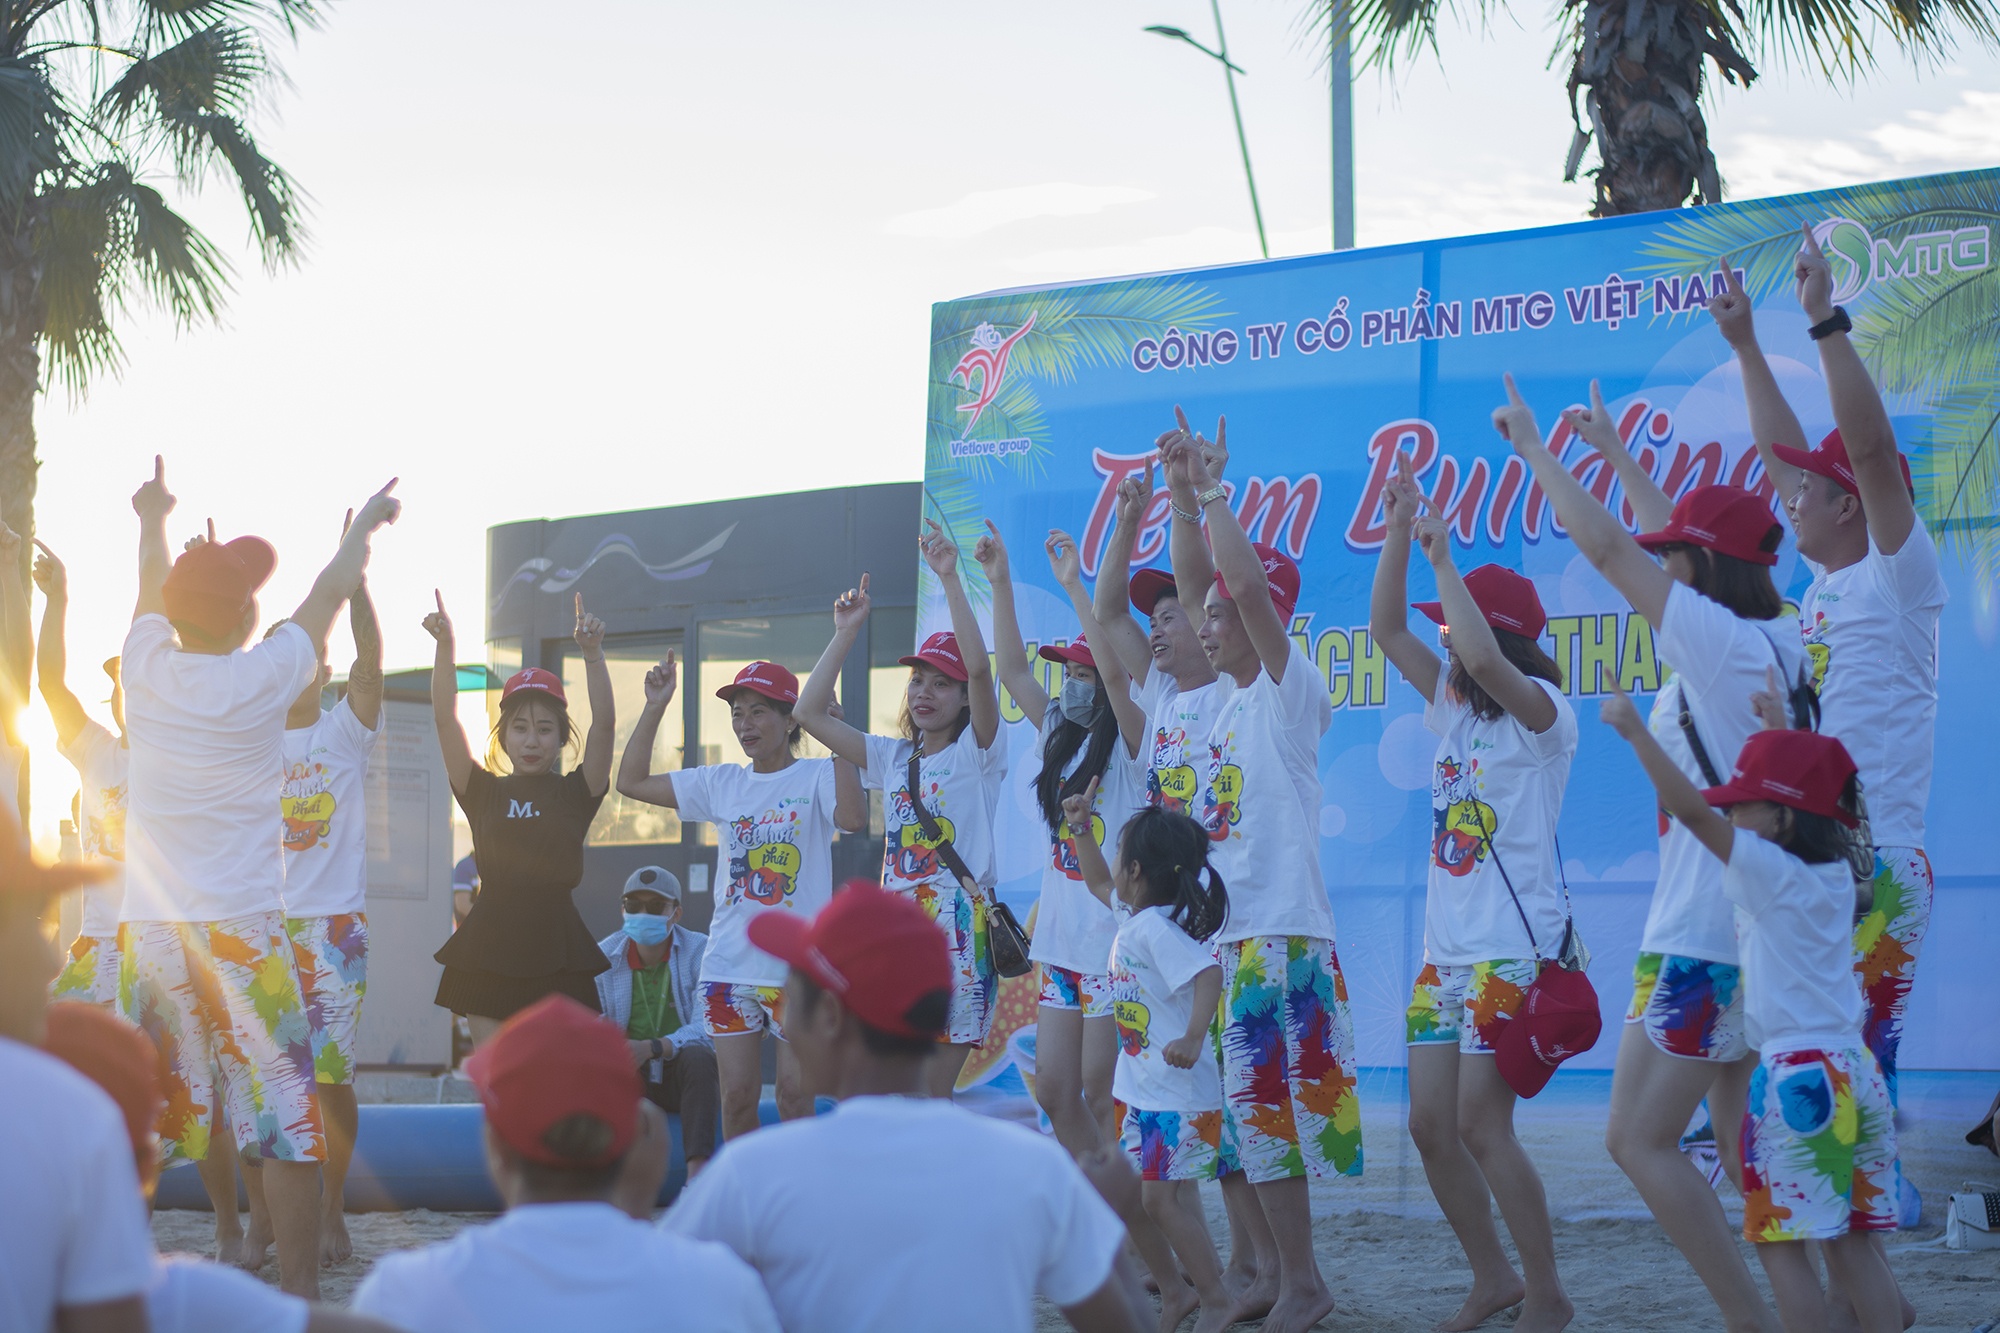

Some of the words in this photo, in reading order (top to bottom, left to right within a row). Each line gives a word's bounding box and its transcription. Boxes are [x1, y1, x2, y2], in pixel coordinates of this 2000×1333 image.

[1875, 226, 1989, 281] MTG
[1132, 326, 1239, 372] CÔNG
[1247, 322, 1287, 360] TY
[1295, 296, 1352, 354] CỔ
[1361, 288, 1461, 347] PHẦN
[1472, 291, 1556, 335] MTG
[1564, 273, 1643, 331] VIỆT
[951, 440, 996, 457] Vietlove
[999, 437, 1031, 458] group
[507, 798, 540, 819] M.
